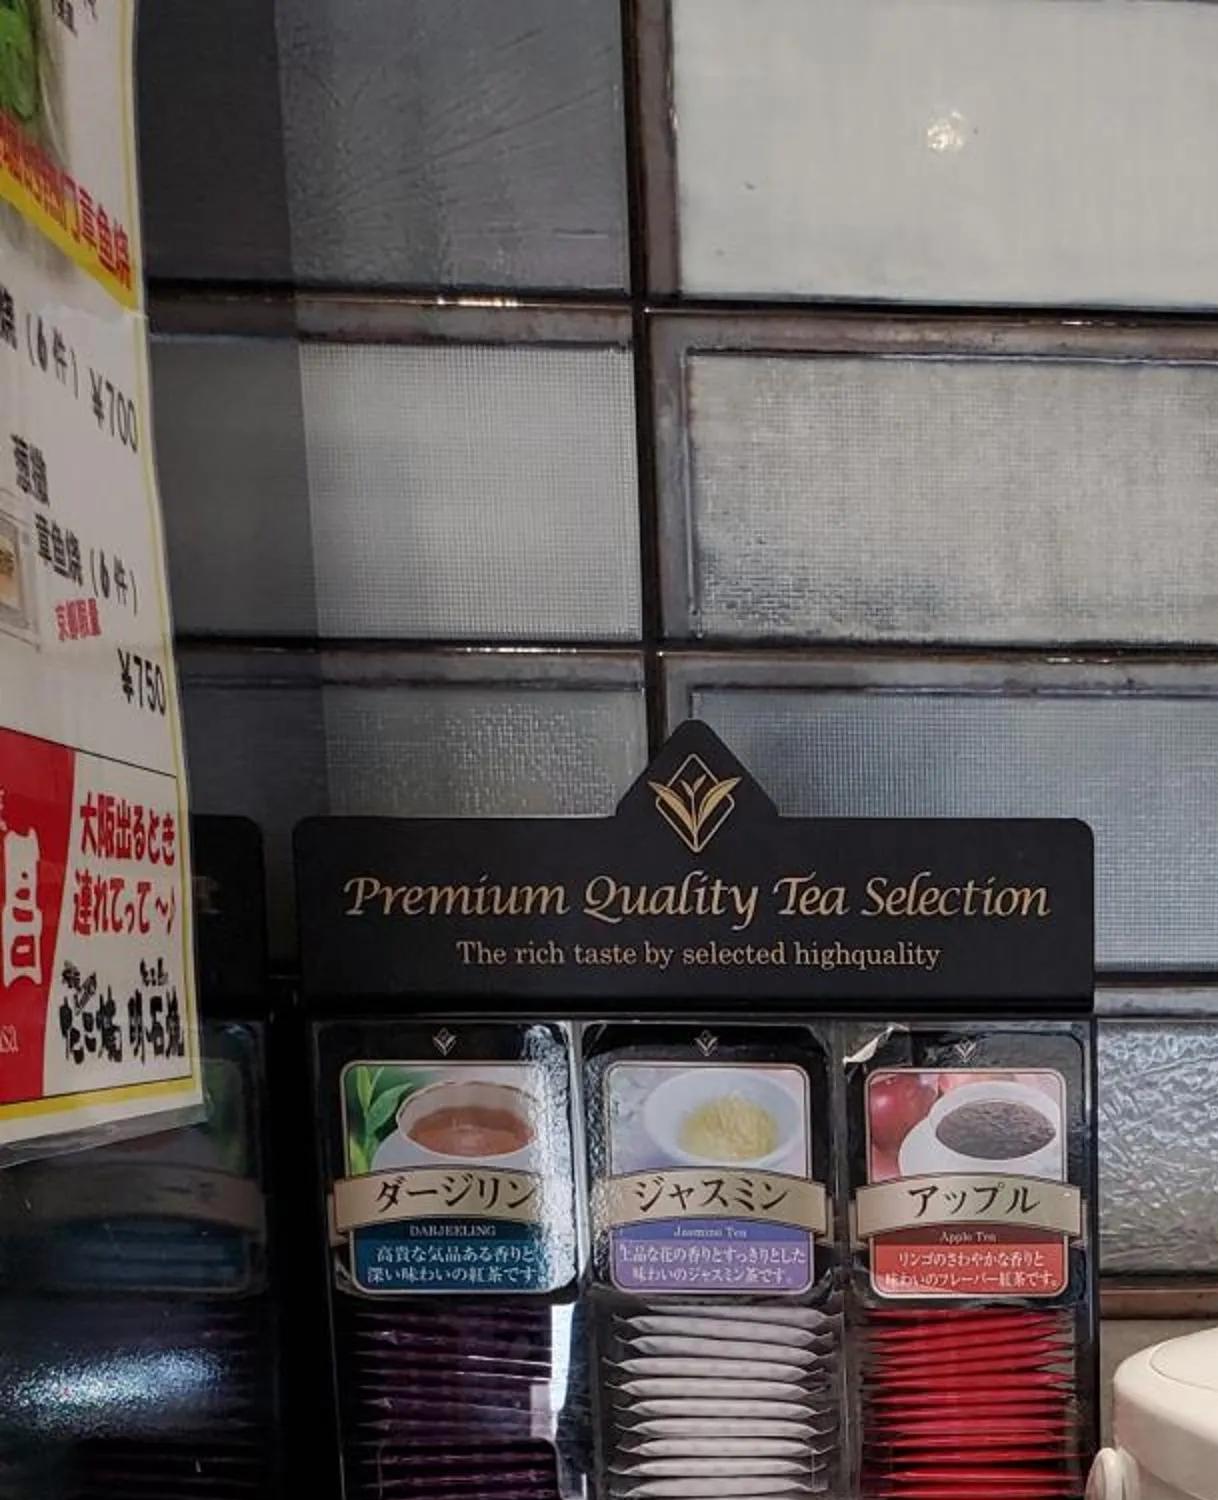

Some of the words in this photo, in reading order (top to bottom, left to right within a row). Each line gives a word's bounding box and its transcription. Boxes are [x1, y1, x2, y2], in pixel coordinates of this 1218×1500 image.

[90, 368, 138, 453] ¥700
[117, 648, 165, 716] ¥750
[79, 790, 176, 866] 大阪出るとき
[343, 872, 571, 917] Premium
[584, 870, 759, 931] Quality
[772, 871, 850, 917] Tea
[860, 871, 1052, 918] Selection
[456, 941, 508, 965] The
[515, 941, 565, 965] rich
[574, 943, 637, 965] taste
[645, 941, 675, 969] by
[683, 941, 786, 965] selected
[794, 941, 942, 970] highquality
[376, 1173, 537, 1213] ダージリン
[634, 1176, 789, 1213] ジャスミン
[908, 1181, 1042, 1218] アップル
